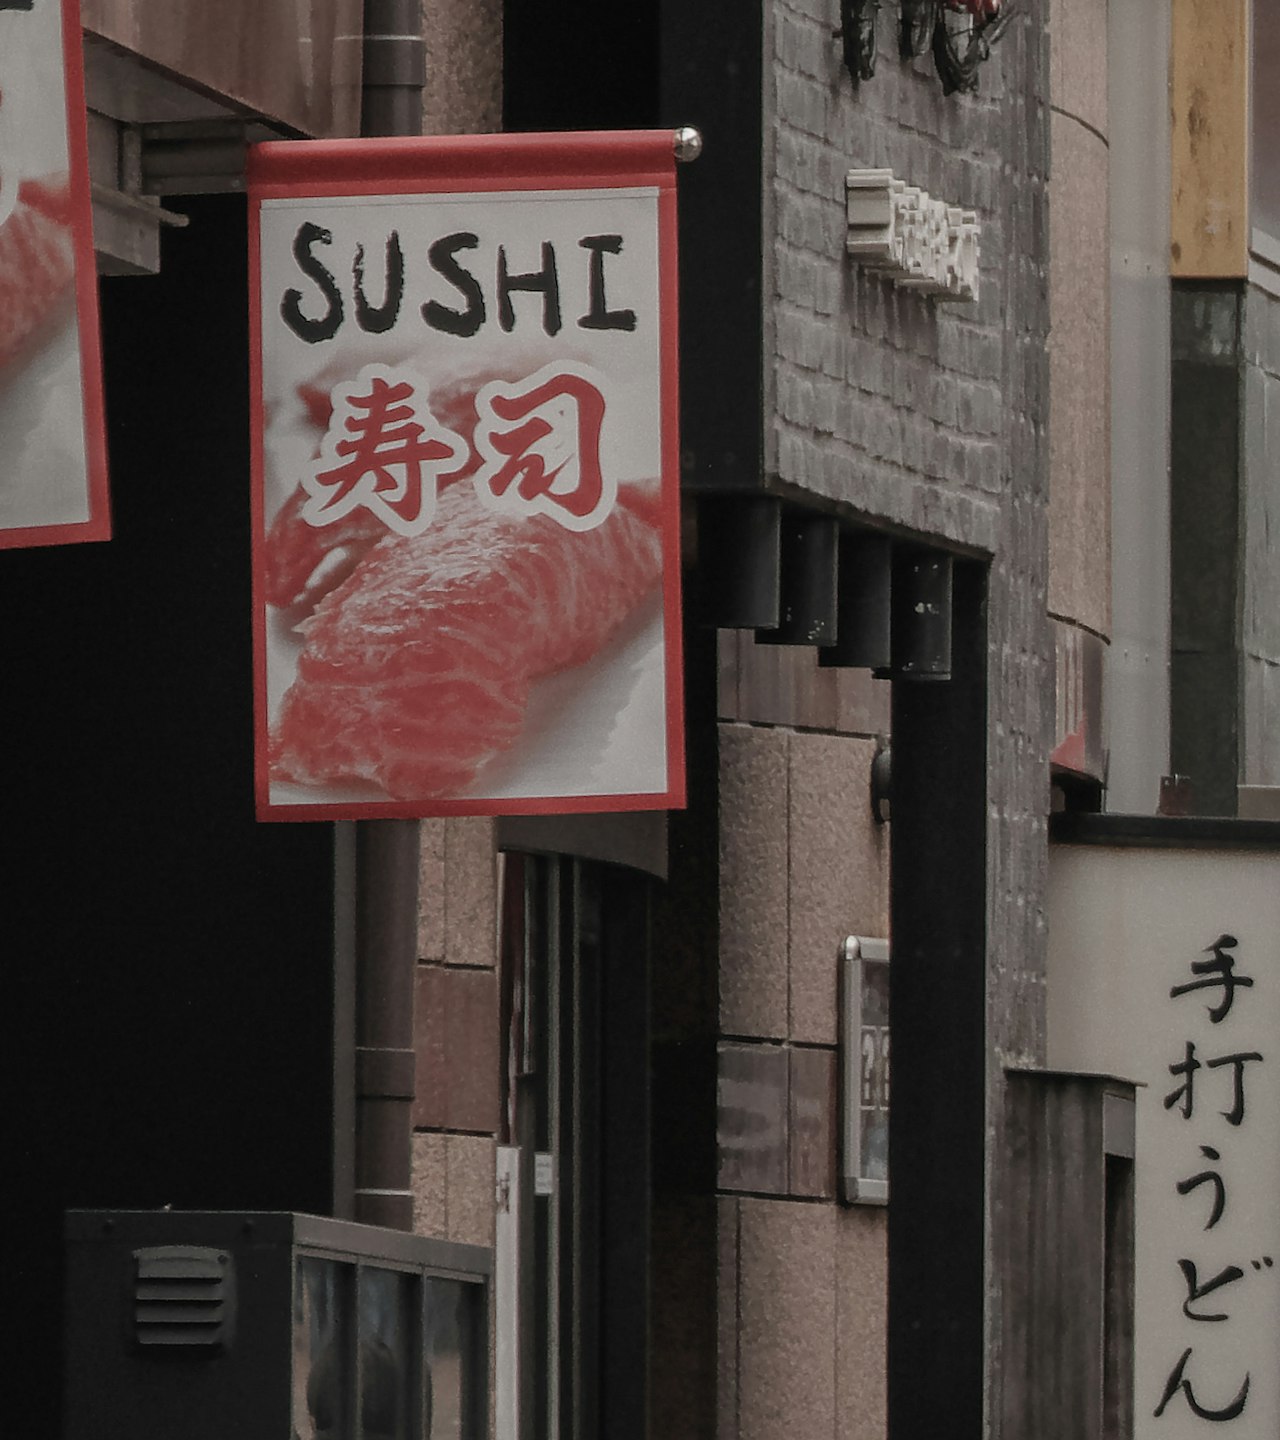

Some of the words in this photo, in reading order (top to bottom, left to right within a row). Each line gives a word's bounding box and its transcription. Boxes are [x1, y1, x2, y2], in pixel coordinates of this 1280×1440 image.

[281, 222, 638, 345] SUSHI
[314, 373, 606, 522] 寿司
[1153, 934, 1275, 1422] 手打うどん
